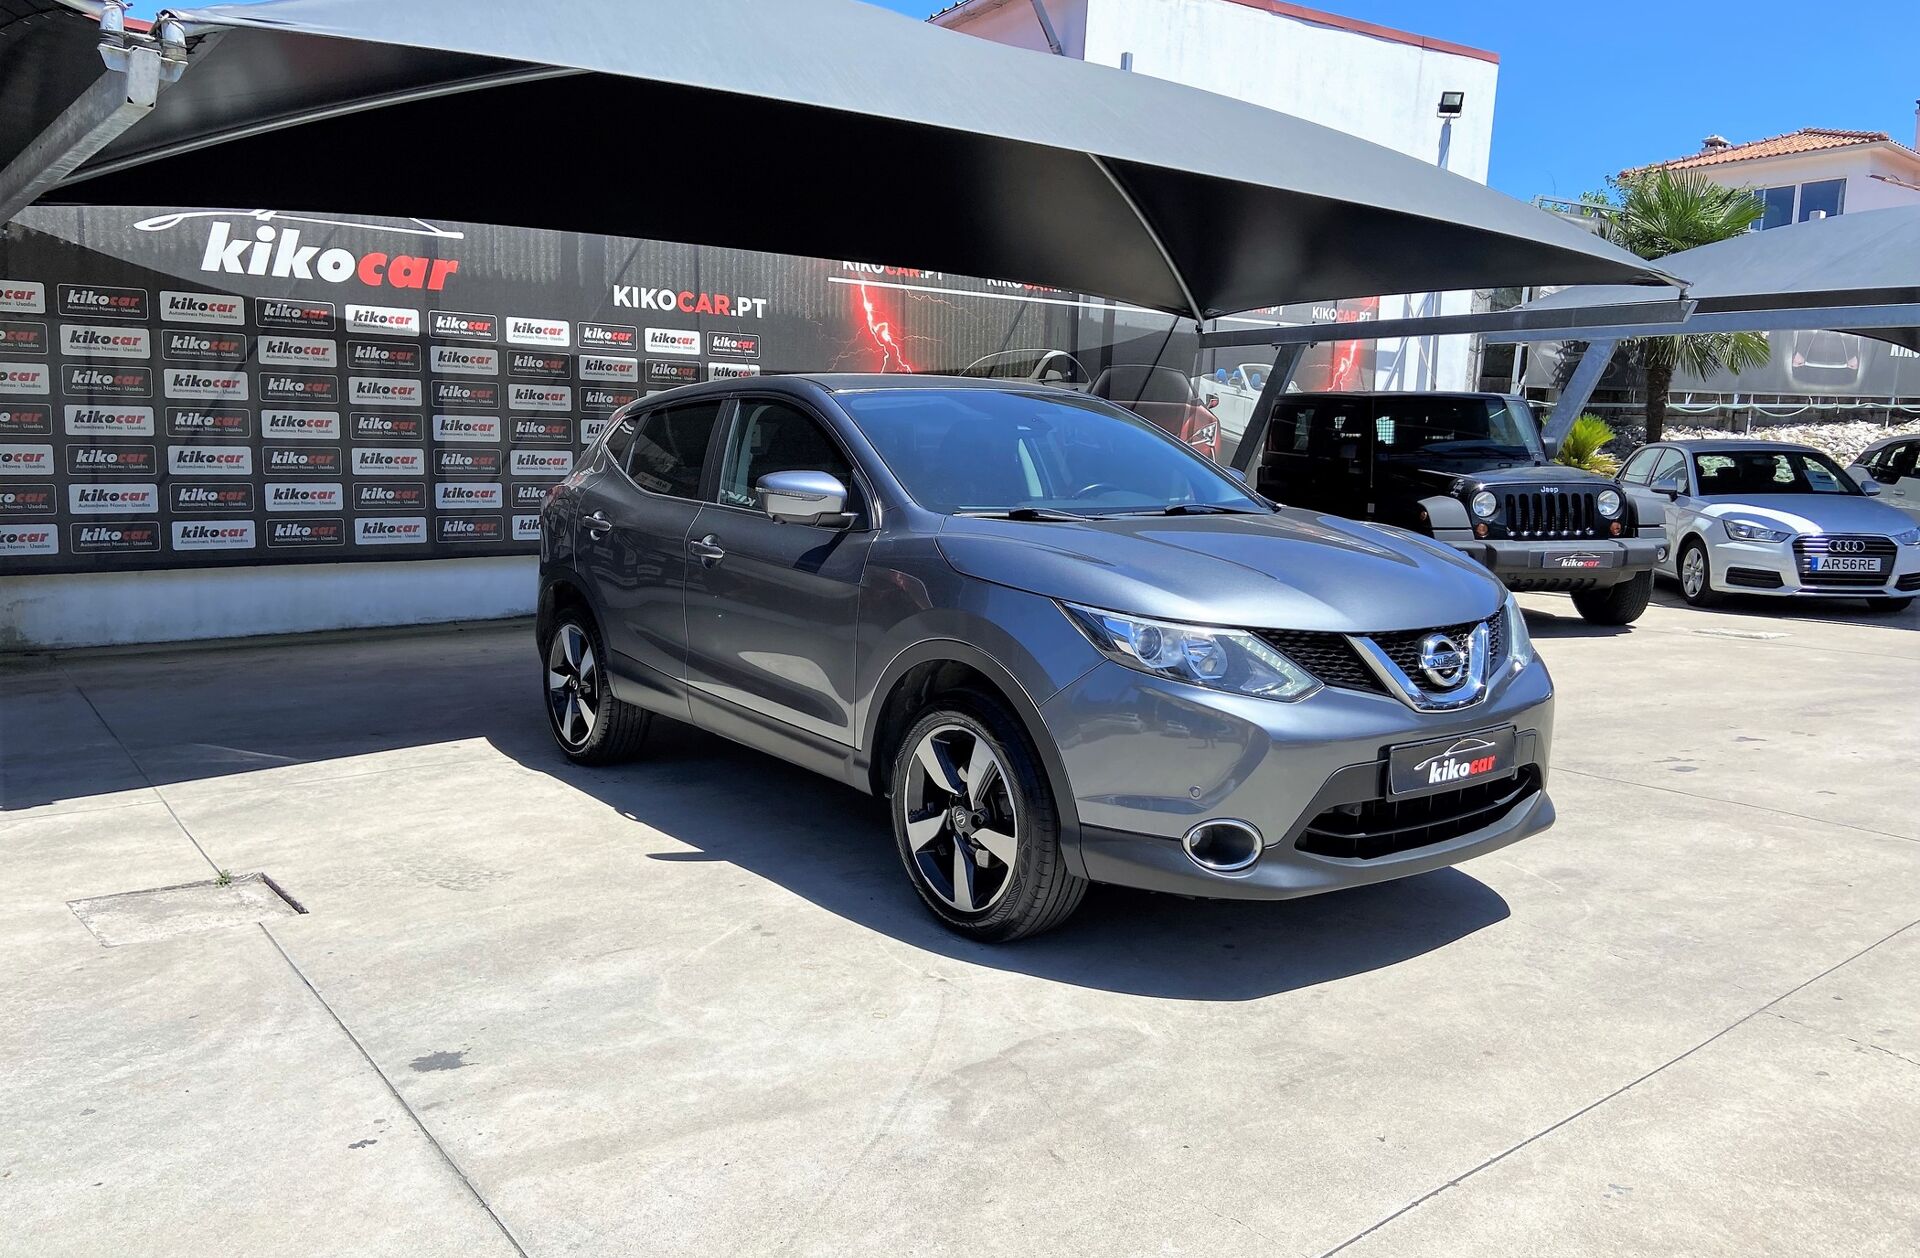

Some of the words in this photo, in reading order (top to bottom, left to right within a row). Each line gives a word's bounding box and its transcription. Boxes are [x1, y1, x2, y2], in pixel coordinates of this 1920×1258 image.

[200, 221, 459, 291] kikocar
[66, 289, 140, 306] kikocar
[613, 284, 767, 318] KIKOCAR.PT
[169, 296, 237, 313] kikocar
[264, 303, 328, 319] kikocar
[353, 309, 412, 325] kikocar
[1312, 306, 1372, 322] KIKOCAR.PT
[435, 315, 490, 330] kikocar
[512, 321, 563, 335] kikocar
[69, 329, 141, 345] kikocar
[584, 326, 632, 340] kikocar
[651, 332, 695, 345] kikocar
[171, 334, 239, 350] kikocar
[266, 340, 329, 355] kikocar
[354, 345, 413, 360] kikocar
[437, 350, 491, 364] kikocar
[513, 354, 564, 368] kikocar
[585, 359, 632, 372] kikocar
[651, 363, 696, 375] kikocar
[70, 369, 143, 385] kikocar
[173, 373, 240, 388] kikocar
[267, 377, 330, 391] kikocar
[356, 381, 414, 394] kikocar
[438, 384, 492, 397] kikocar
[514, 388, 565, 400] kikocar
[73, 409, 145, 423] kikocar
[174, 411, 242, 425] kikocar
[269, 414, 332, 427] kikocar
[357, 416, 416, 429] kikocar
[439, 418, 493, 431] kikocar
[515, 420, 566, 432] kikocar
[0, 453, 44, 462] ocar
[75, 449, 147, 462] kikocar
[177, 450, 244, 463] kikocar
[271, 451, 334, 463] kikocar
[359, 452, 417, 464] kikocar
[440, 452, 495, 464] kikocar
[516, 454, 567, 465] kikocar
[78, 489, 149, 502] kikocar
[178, 488, 246, 500] kikocar
[273, 487, 335, 499] kikocar
[360, 487, 418, 499] kikocar
[442, 486, 496, 498] kikocar
[181, 526, 247, 538] kikocar
[274, 523, 337, 536] kikocar
[362, 522, 420, 534] kikocar
[443, 520, 497, 532] kikocar
[80, 528, 152, 541] kikocar
[1561, 559, 1600, 567] kikocar
[1428, 755, 1496, 784] kikocar
